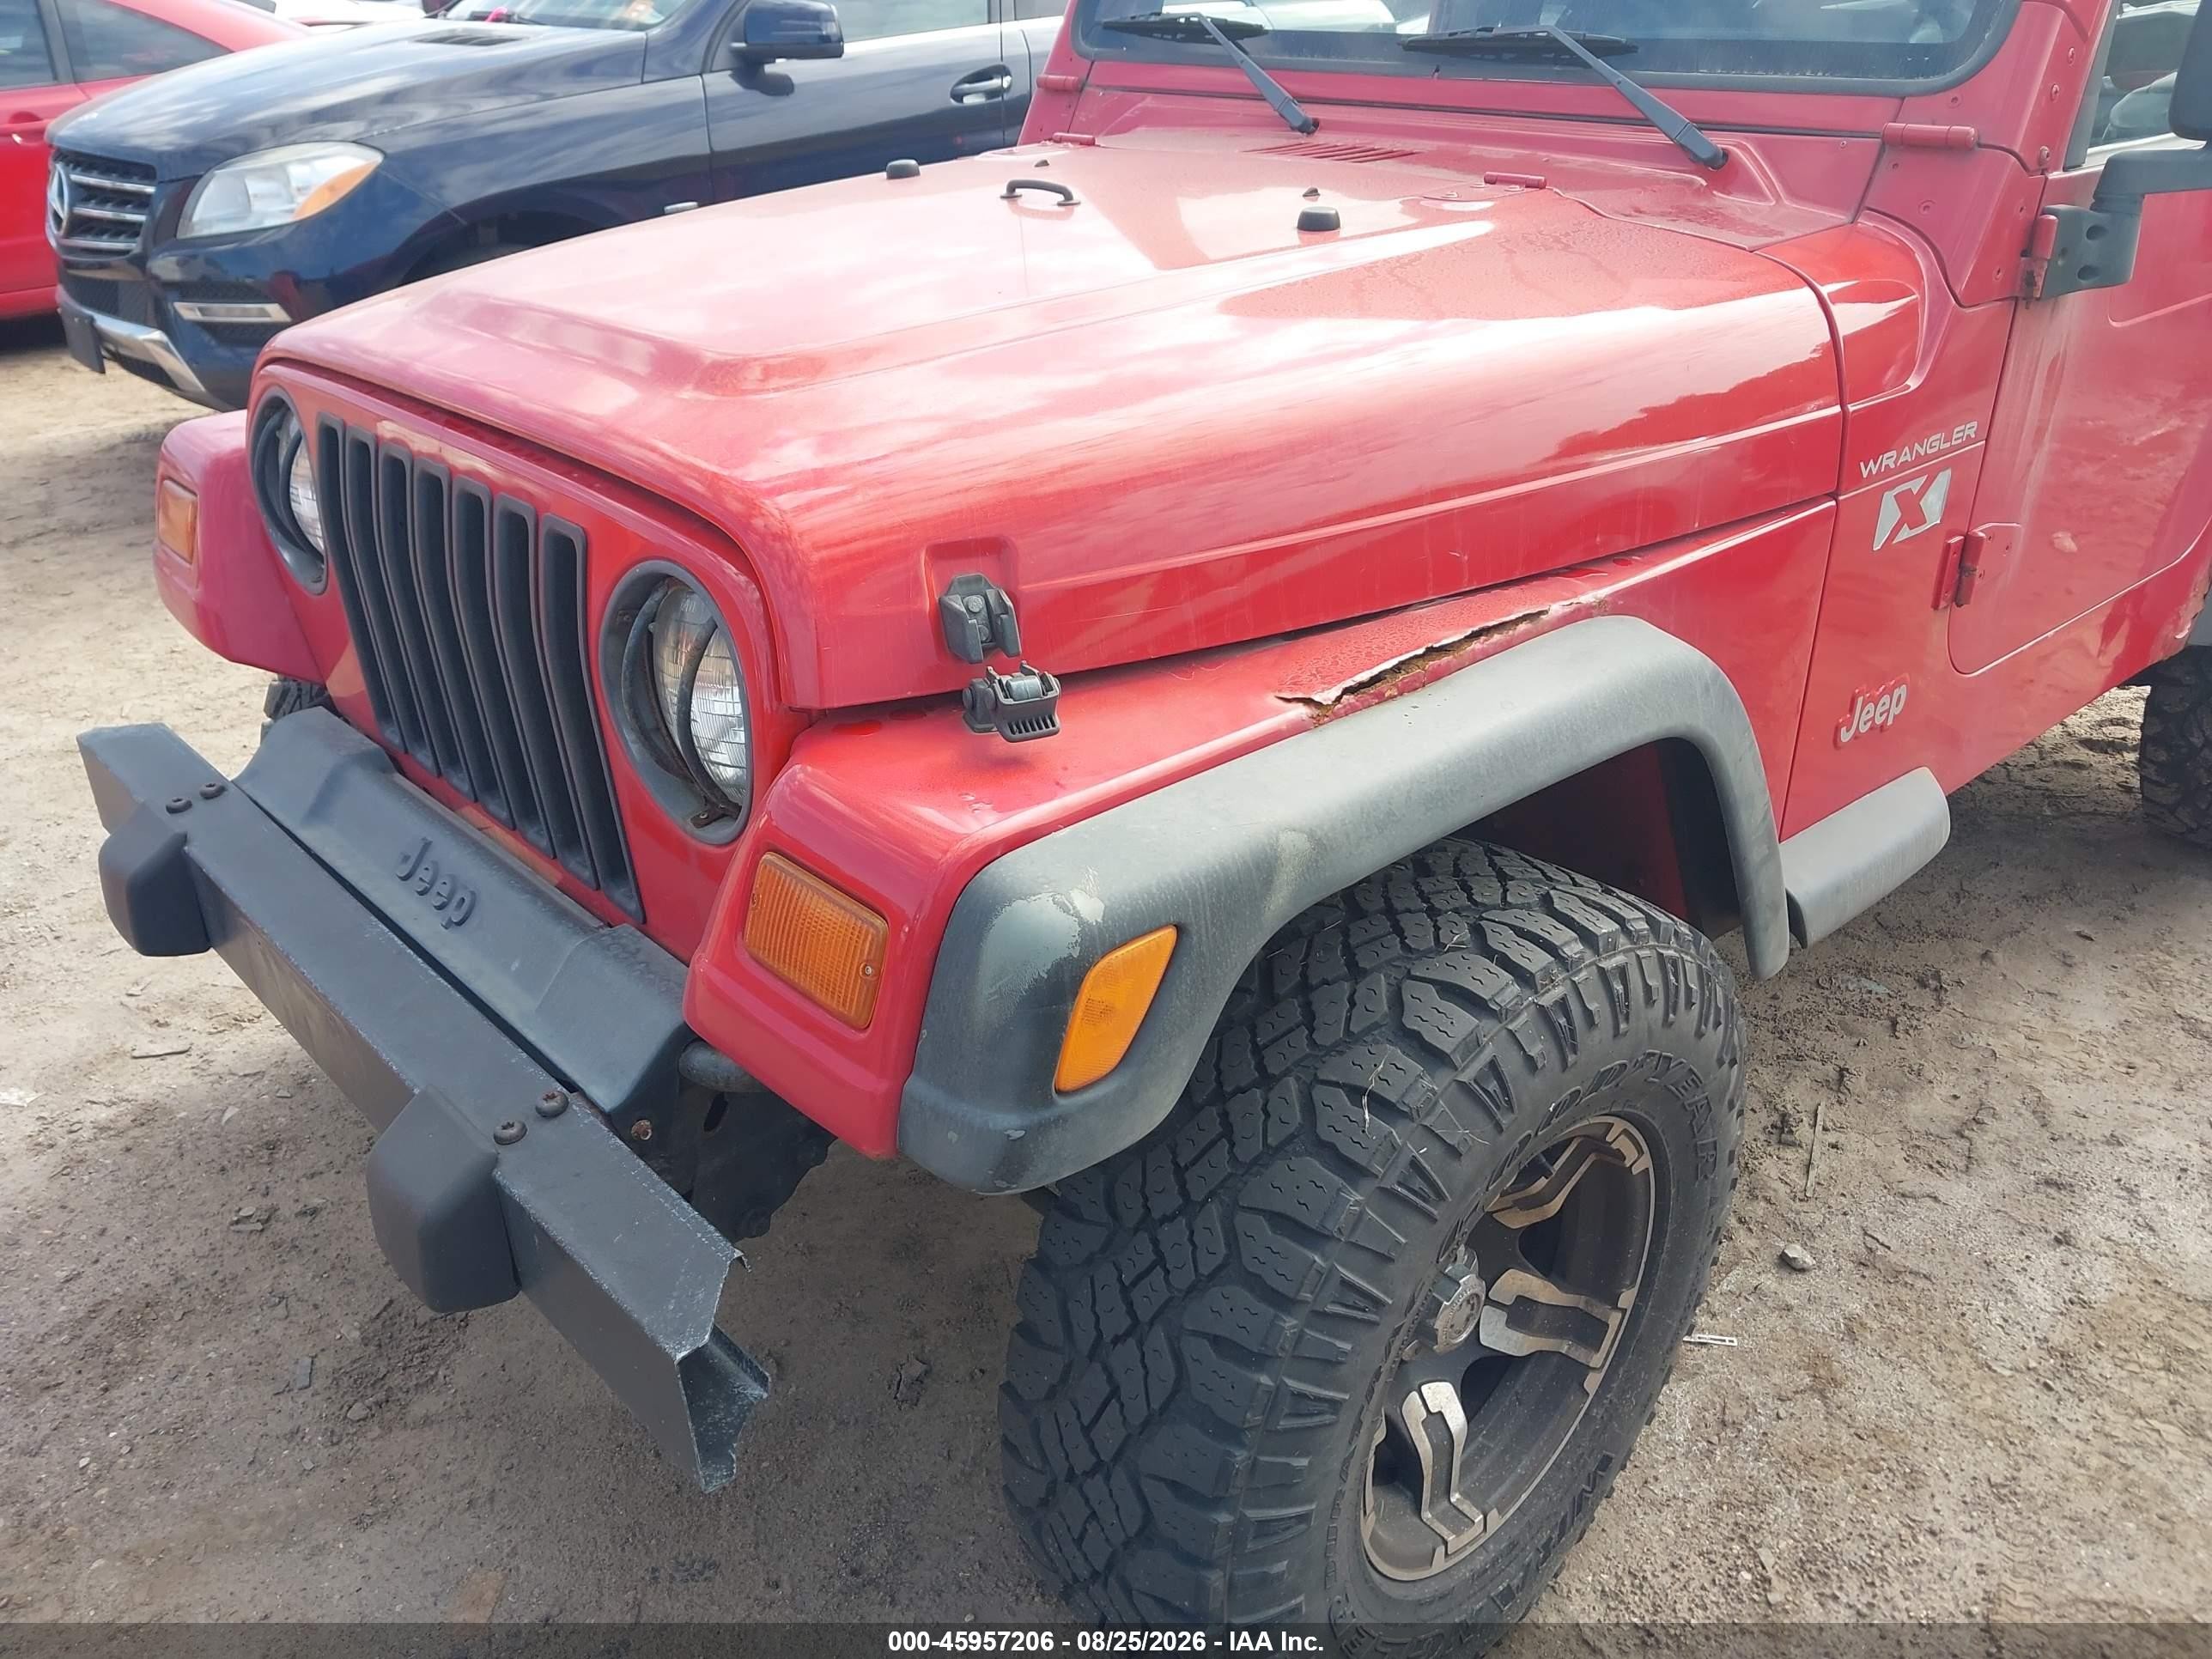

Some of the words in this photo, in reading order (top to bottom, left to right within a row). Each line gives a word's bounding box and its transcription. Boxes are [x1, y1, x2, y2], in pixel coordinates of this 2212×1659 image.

[1859, 421, 1978, 478] WRANGLER
[1840, 684, 1907, 743] Jeep
[396, 838, 477, 930] Jeep
